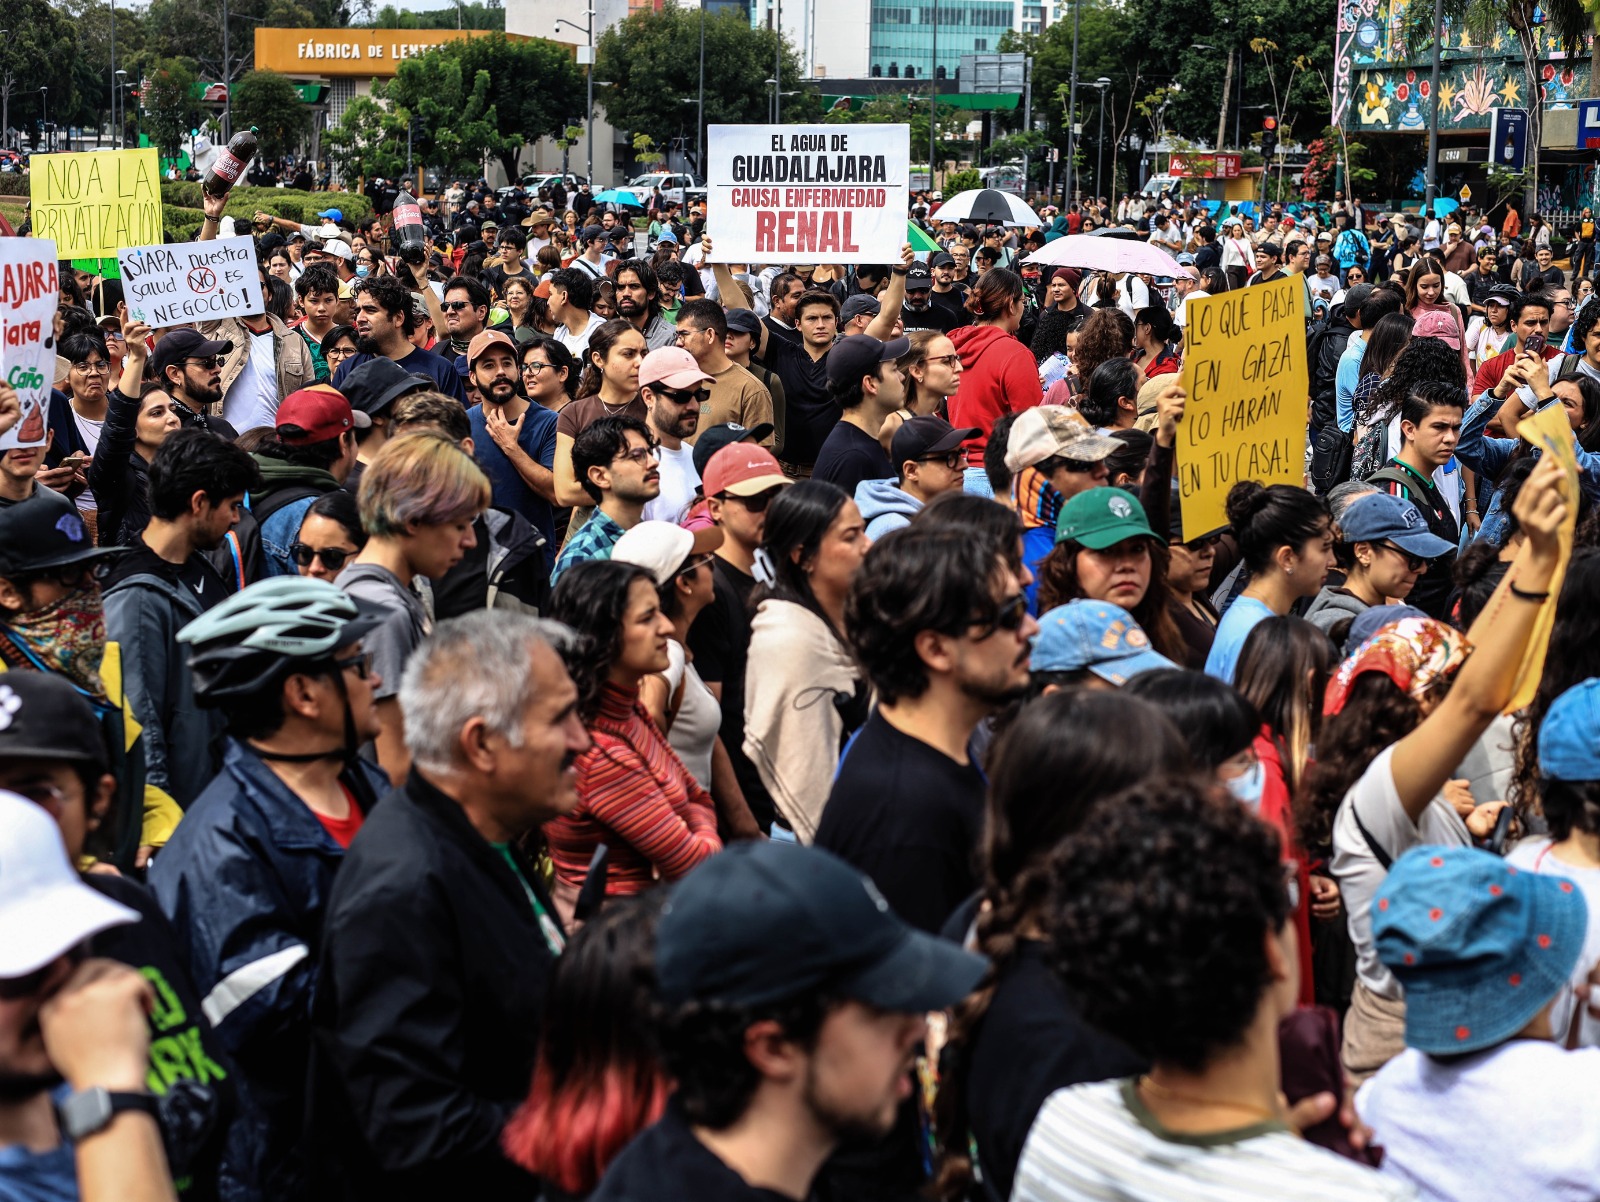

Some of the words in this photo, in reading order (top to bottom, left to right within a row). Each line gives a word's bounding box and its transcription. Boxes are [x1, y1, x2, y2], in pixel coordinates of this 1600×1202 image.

[298, 39, 361, 59] FÁBRICA
[368, 45, 383, 58] DE
[771, 134, 786, 152] EL
[791, 134, 826, 152] AGUA
[831, 134, 848, 152] DE
[47, 159, 81, 200] NO
[86, 157, 103, 196] A
[118, 158, 153, 200] LA
[732, 155, 887, 183] GUADALAJARA
[731, 188, 780, 208] CAUSA
[785, 188, 886, 208] ENFERMEDAD
[35, 199, 162, 254] PRIVATIZACIÓN
[755, 211, 859, 253] RENAL
[188, 245, 249, 269] nuestra
[0, 261, 60, 310] AJARA
[132, 276, 177, 302] salud
[189, 271, 216, 290] NO
[1219, 293, 1252, 339] QUE
[1261, 285, 1295, 328] PASA
[1192, 359, 1222, 402] EN
[1241, 333, 1292, 383] GAZA
[1189, 411, 1211, 447] LO
[1221, 385, 1282, 437] HARÁN
[1180, 462, 1201, 498] EN
[1207, 451, 1230, 489] TU
[1235, 437, 1289, 484] CASA!
